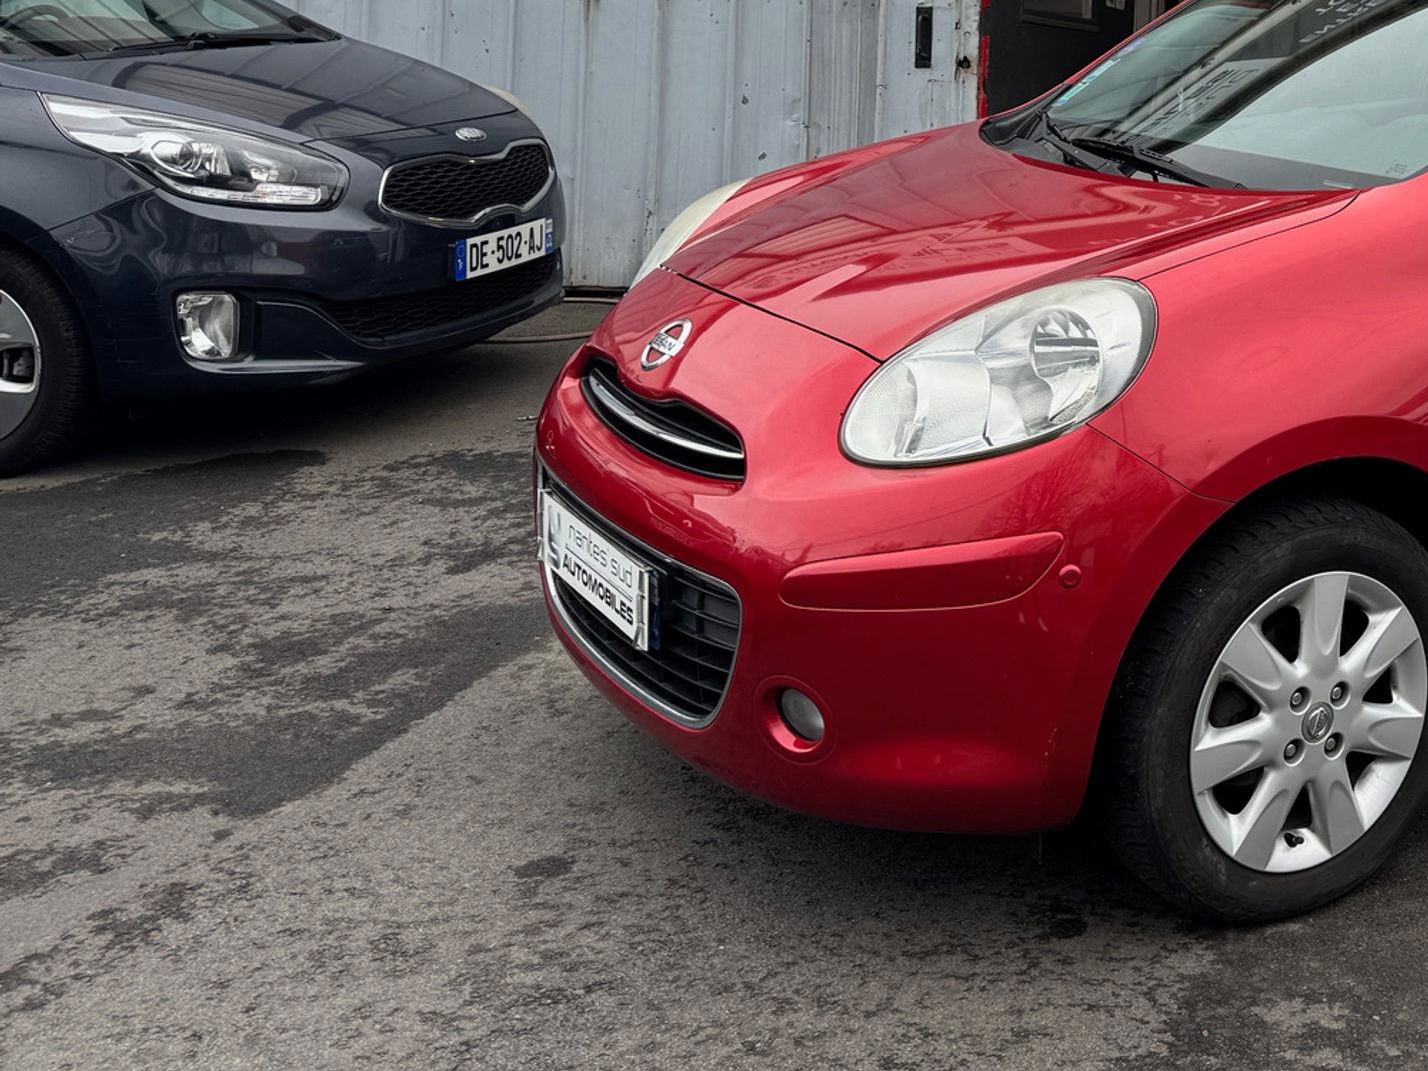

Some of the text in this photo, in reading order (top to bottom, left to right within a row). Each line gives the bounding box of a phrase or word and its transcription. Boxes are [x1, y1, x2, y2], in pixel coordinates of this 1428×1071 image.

[469, 224, 544, 273] DE-502-AJ
[568, 524, 634, 589] nantes sud
[562, 553, 635, 627] AUTOMOBILES
